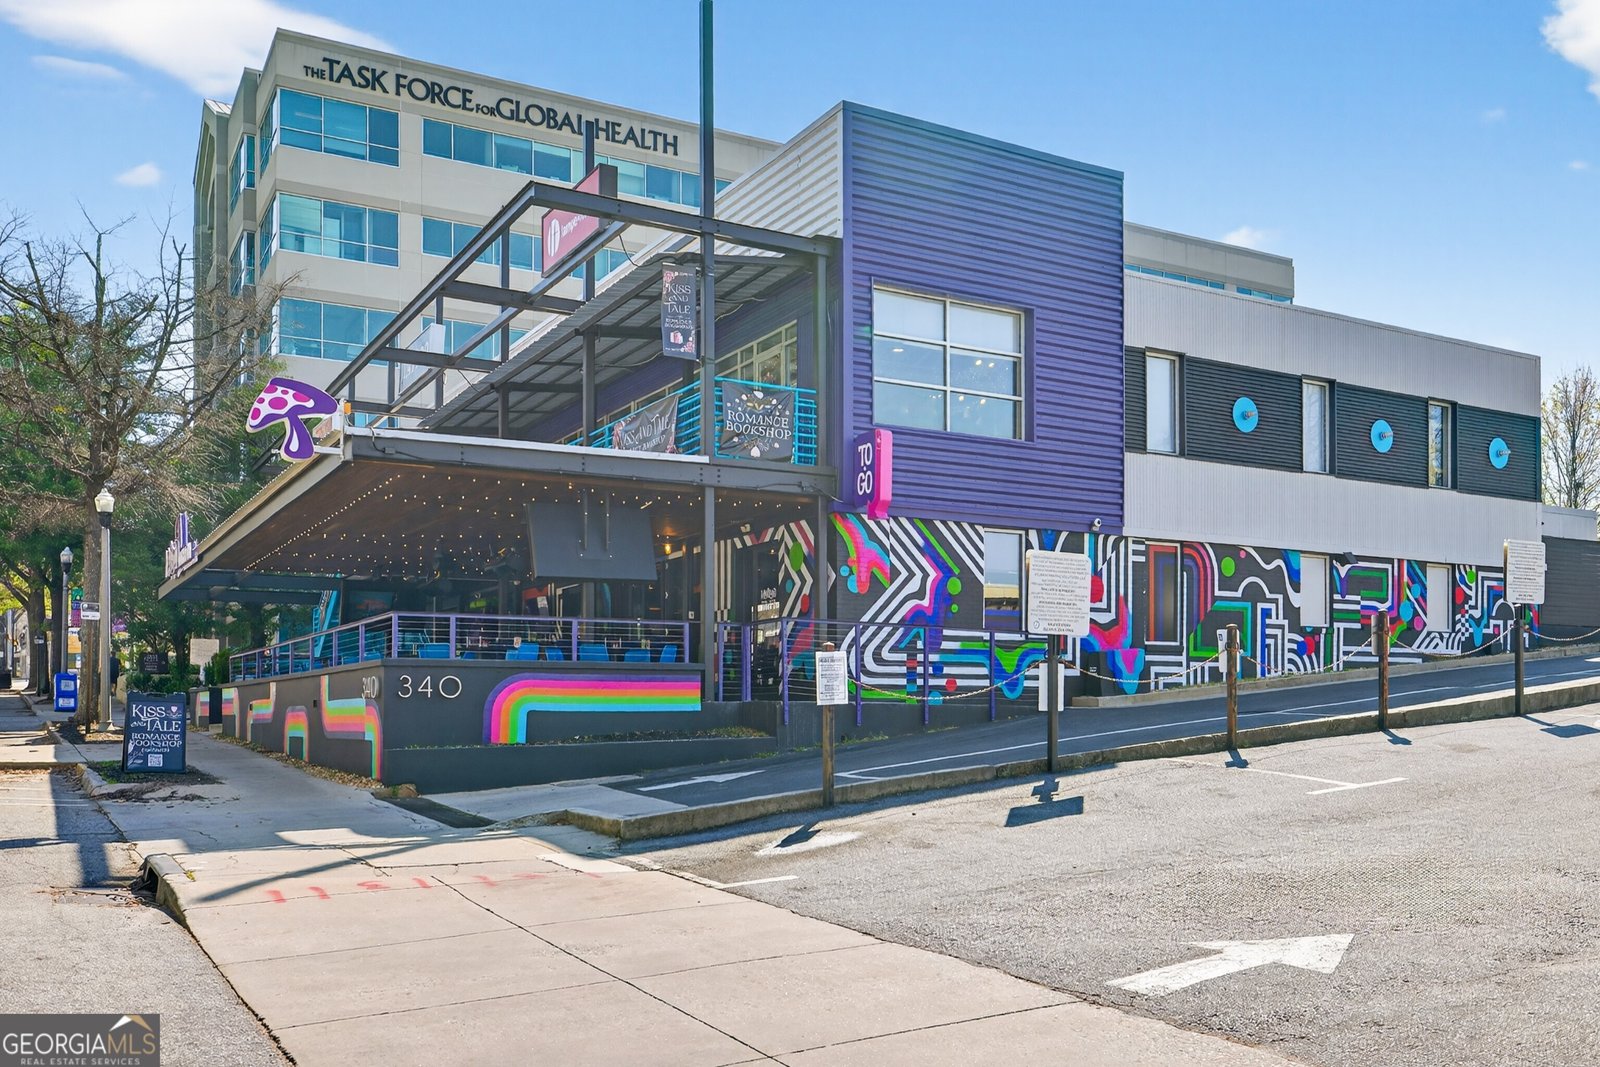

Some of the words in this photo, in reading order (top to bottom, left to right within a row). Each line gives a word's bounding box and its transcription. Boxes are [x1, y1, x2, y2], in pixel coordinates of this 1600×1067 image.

[303, 65, 326, 80] THE
[322, 57, 389, 94] TASK
[395, 73, 474, 112] FORCE
[475, 103, 497, 117] FOR
[495, 97, 583, 136] GLOBAL
[594, 118, 679, 156] HEALTH
[667, 283, 692, 295] KISS
[664, 301, 691, 314] TALE
[727, 410, 789, 429] ROMANCE
[726, 420, 792, 440] BOOKSHOP
[858, 443, 873, 467] TO
[857, 470, 873, 495] GO
[398, 675, 462, 698] 340
[132, 704, 166, 719] KISS
[141, 717, 181, 732] TALE
[131, 732, 180, 741] ROMANCE
